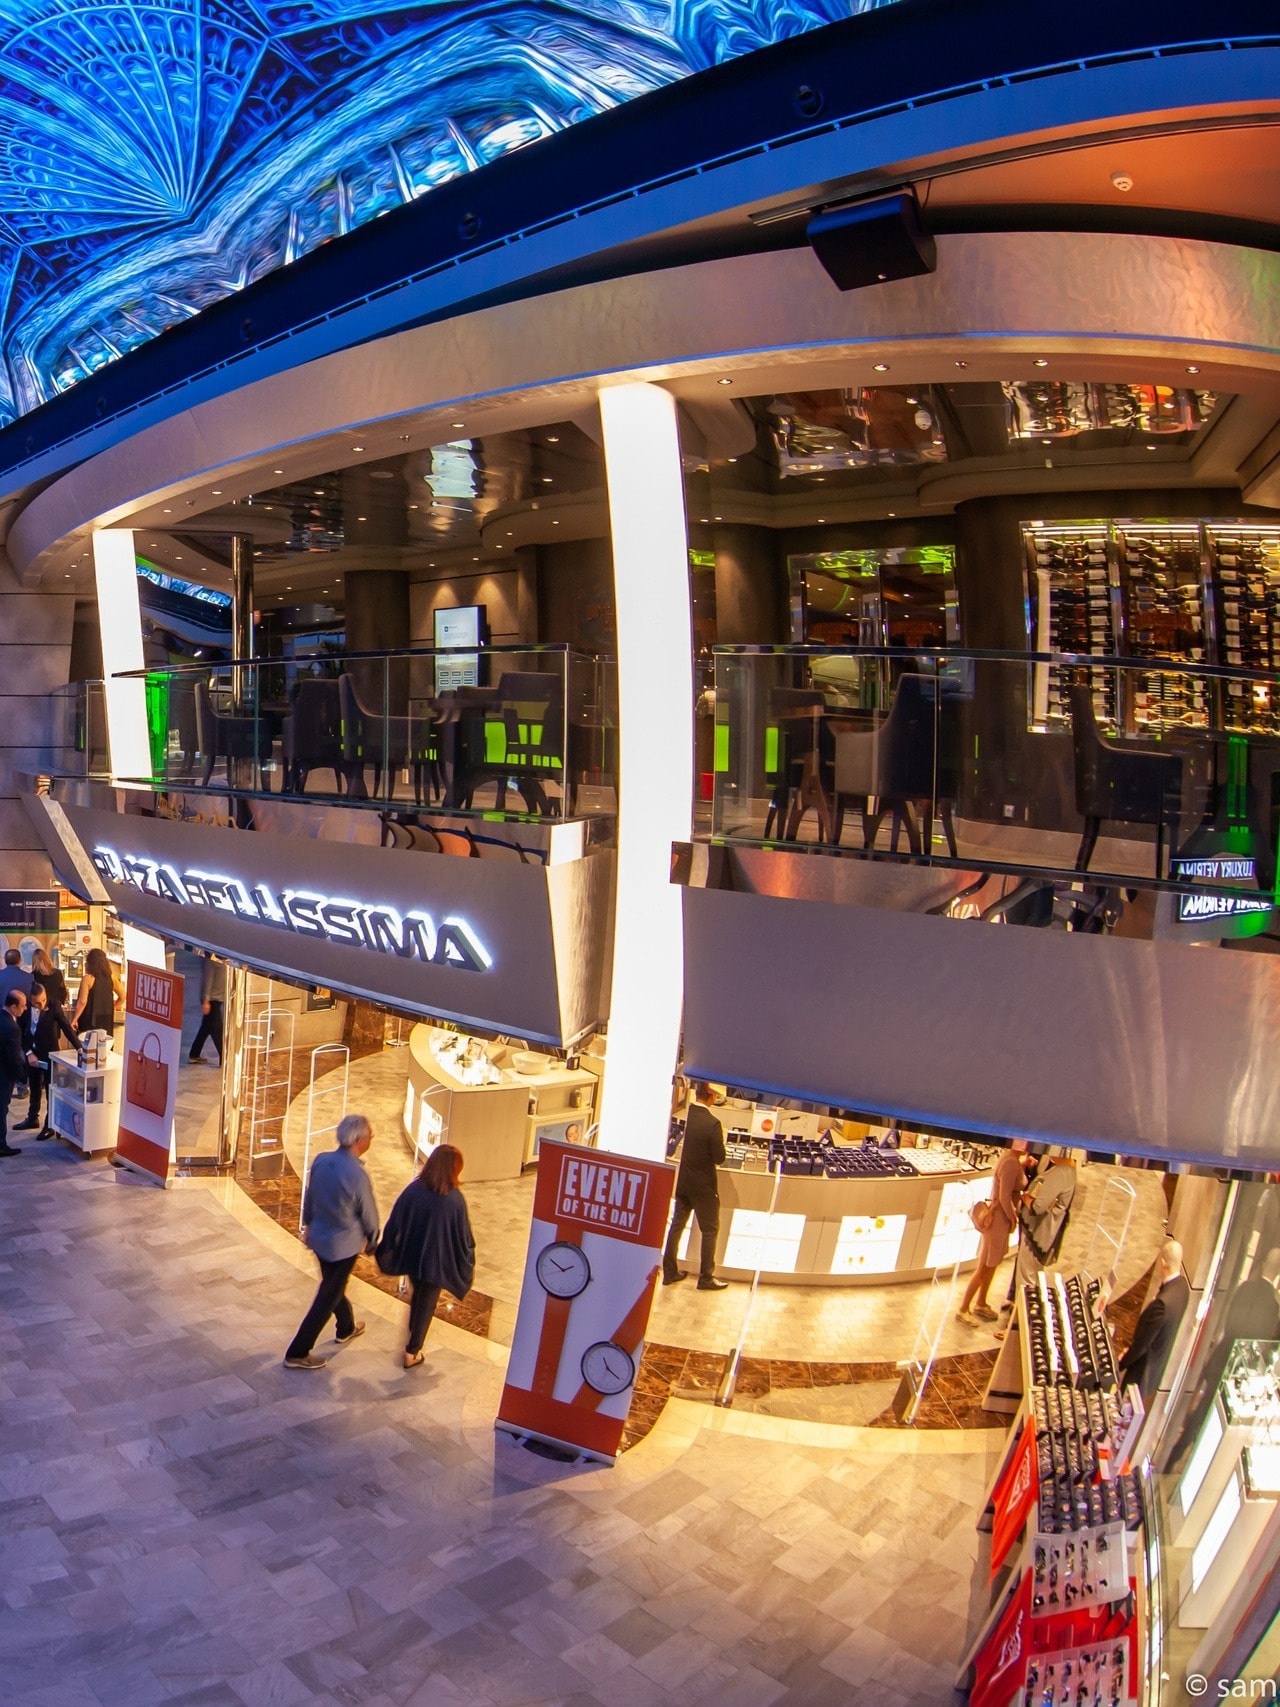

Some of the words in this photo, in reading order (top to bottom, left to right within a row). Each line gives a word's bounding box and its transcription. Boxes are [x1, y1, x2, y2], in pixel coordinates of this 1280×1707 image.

[92, 847, 190, 906] PLAZA
[179, 868, 493, 973] BELLISSIMA
[137, 973, 171, 1005] EVENT
[137, 996, 144, 1008] OF
[145, 1000, 156, 1012] THE
[157, 1003, 168, 1016] DAY
[565, 1160, 642, 1210] EVENT
[562, 1197, 580, 1214] OF
[583, 1202, 608, 1221] THE
[610, 1208, 637, 1228] DAY
